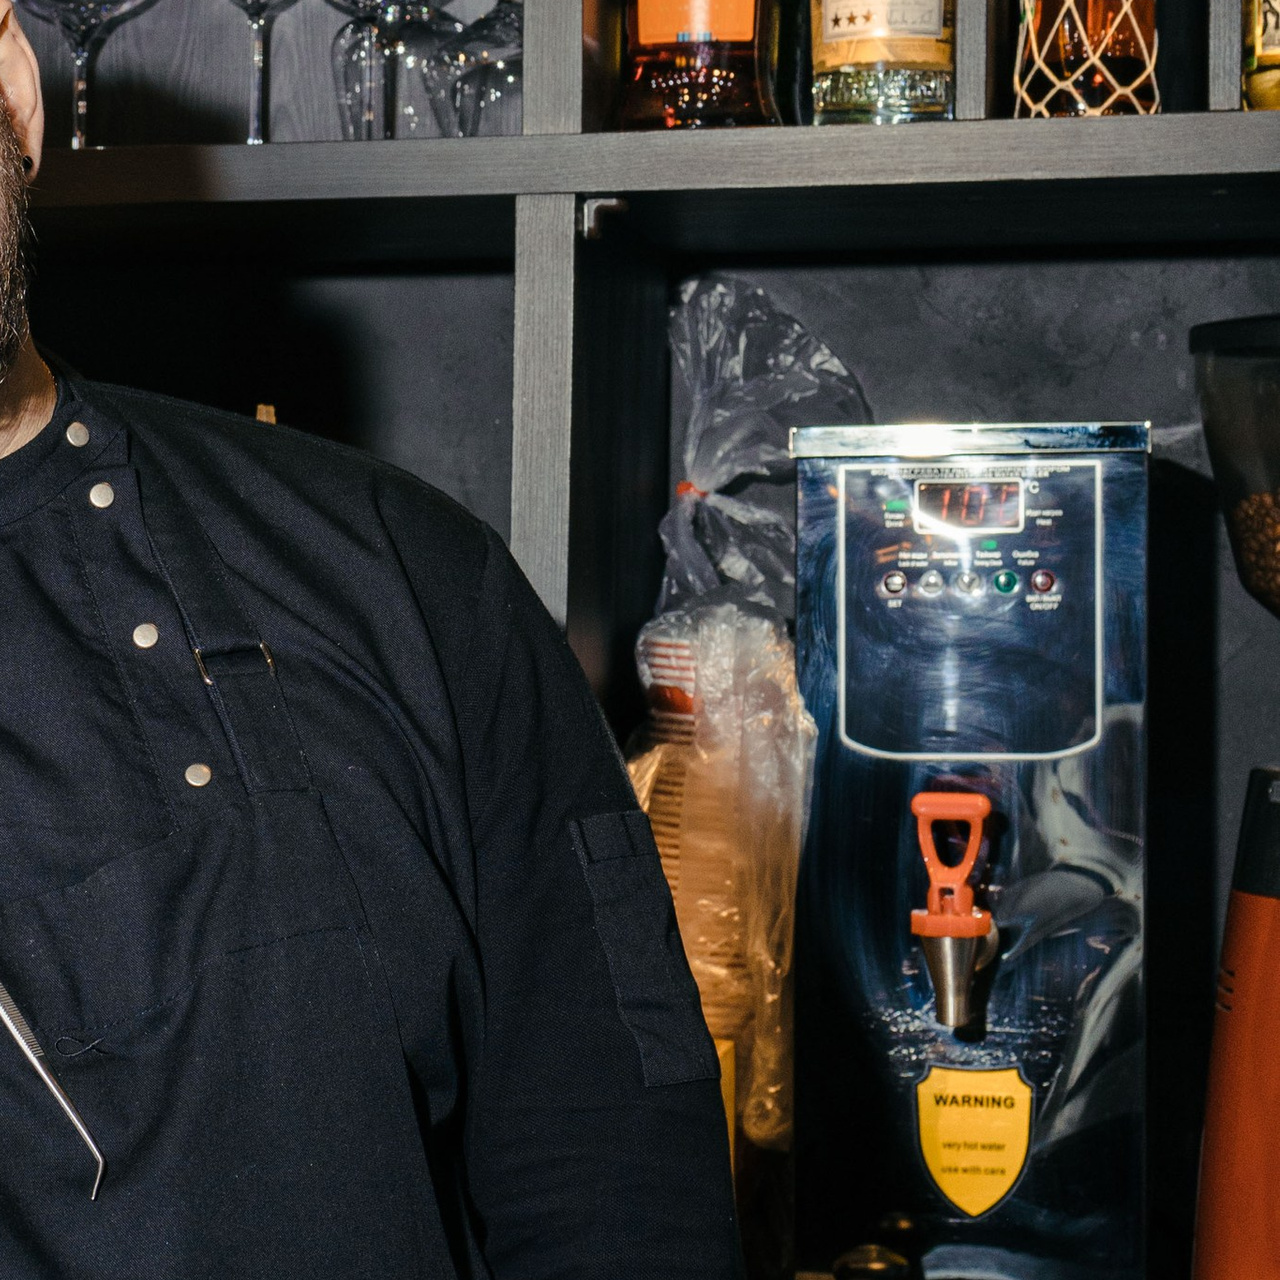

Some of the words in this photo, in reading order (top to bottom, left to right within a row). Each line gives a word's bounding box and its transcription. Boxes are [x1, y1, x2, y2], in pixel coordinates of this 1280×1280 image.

[934, 1094, 1016, 1109] WARNING
[942, 1142, 962, 1152] very
[963, 1141, 979, 1151] hot
[979, 1142, 1006, 1151] water
[961, 1165, 982, 1175] with
[983, 1166, 1007, 1175] care
